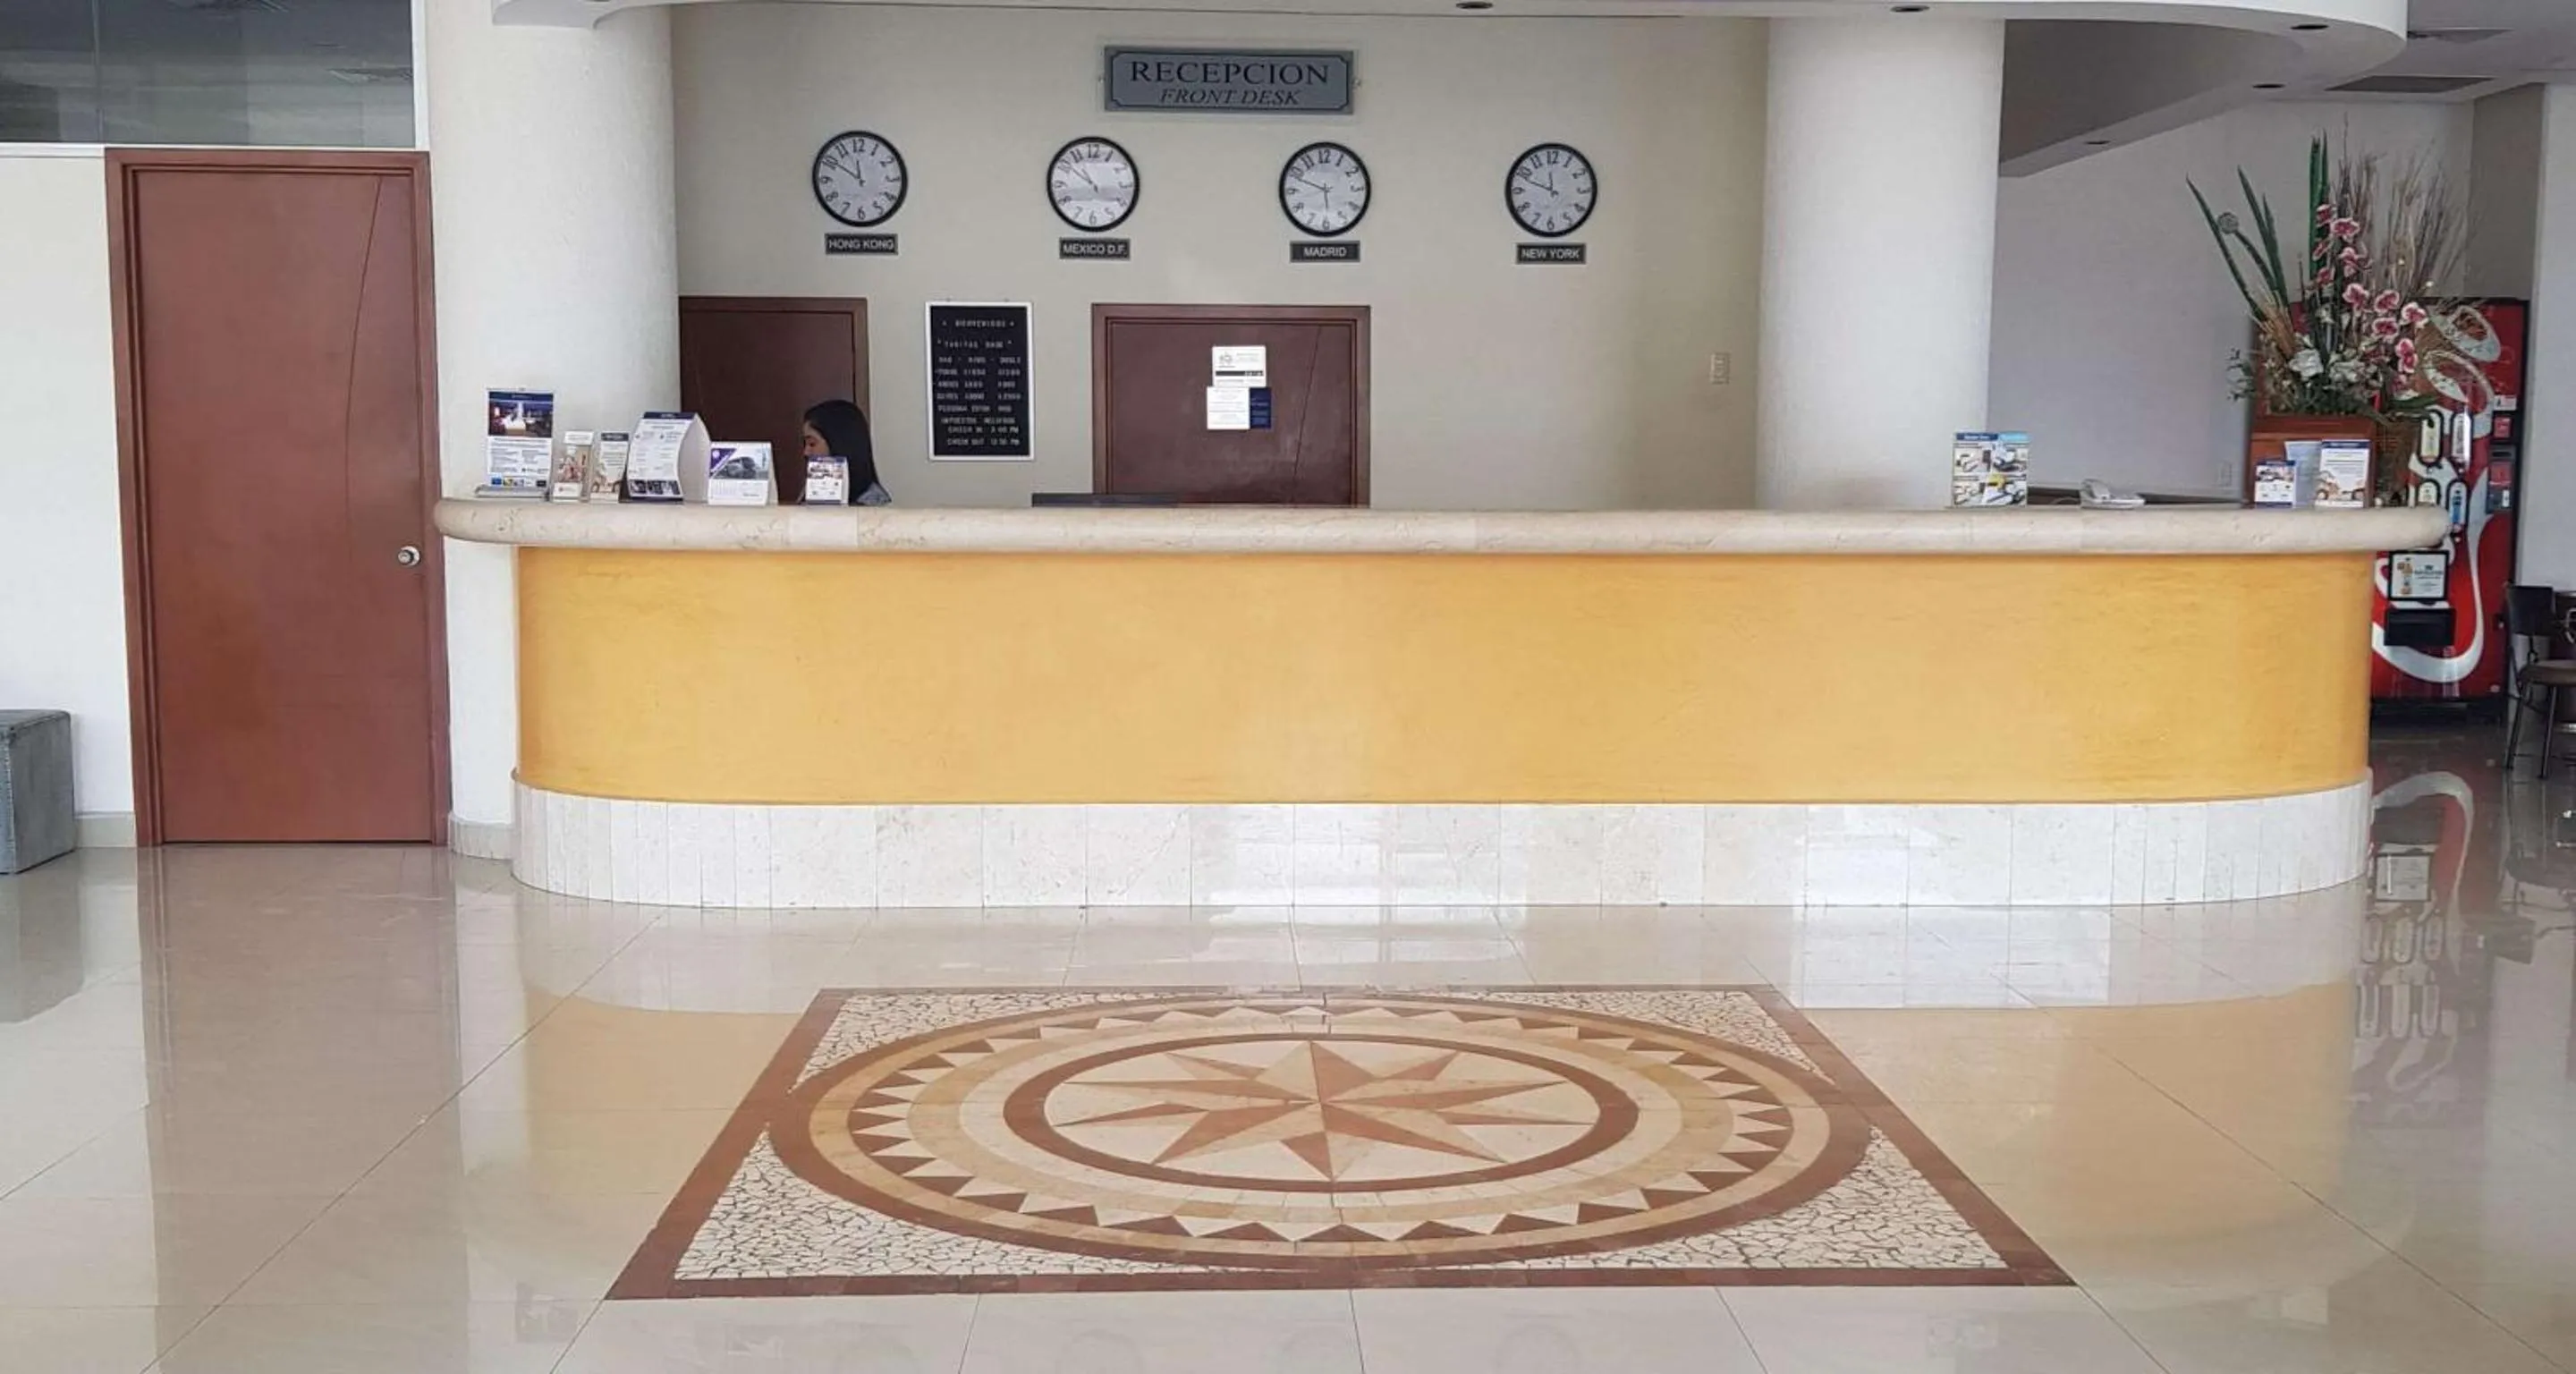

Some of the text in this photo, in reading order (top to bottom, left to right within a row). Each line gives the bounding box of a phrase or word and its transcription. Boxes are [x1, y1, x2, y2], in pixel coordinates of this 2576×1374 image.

[1131, 61, 1329, 85] RECEPCION
[1160, 89, 1303, 106] FRONT DESK
[835, 141, 848, 157] 11
[852, 139, 865, 152] 12
[871, 143, 878, 156] 1
[1088, 143, 1100, 158] 12
[1318, 149, 1330, 164] 12
[1530, 154, 1542, 168] 11
[1547, 151, 1559, 165] 12
[1563, 156, 1572, 167] 1
[858, 206, 866, 220] 6
[1547, 216, 1554, 230] 6
[828, 238, 894, 250] HONG KONG
[1063, 242, 1105, 254] MEXICO
[1303, 246, 1347, 258] MADRID
[1521, 248, 1581, 259] NEW YORK
